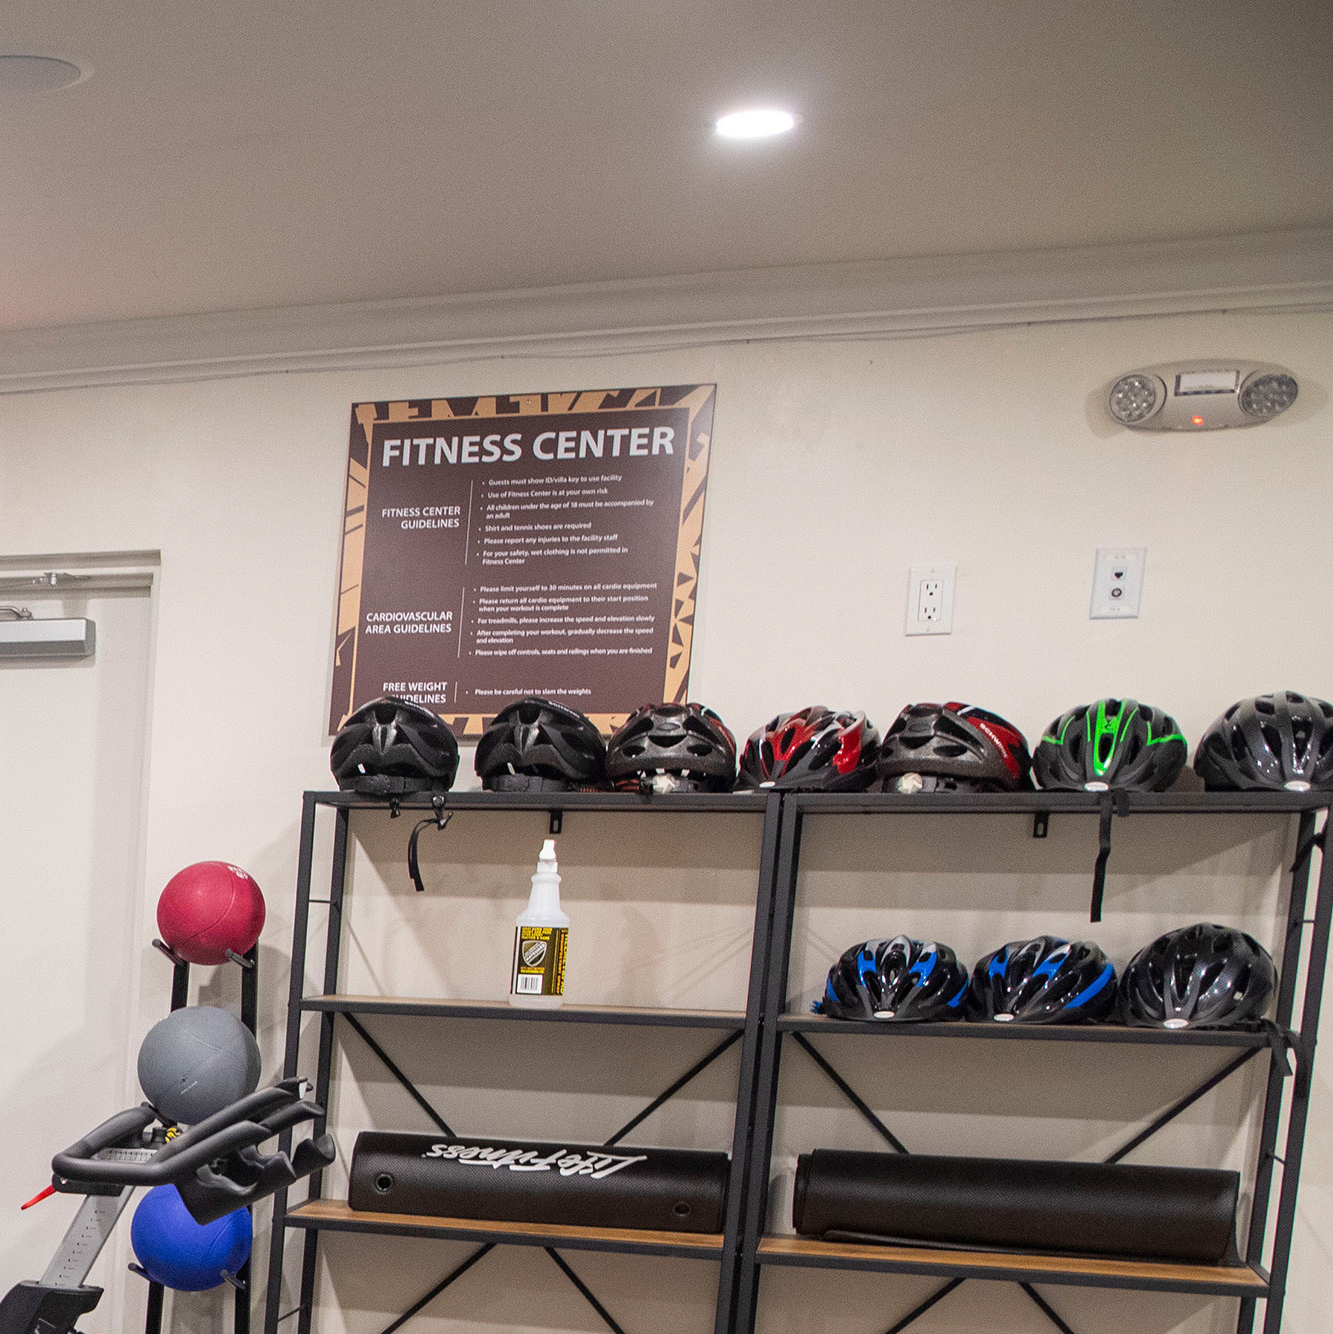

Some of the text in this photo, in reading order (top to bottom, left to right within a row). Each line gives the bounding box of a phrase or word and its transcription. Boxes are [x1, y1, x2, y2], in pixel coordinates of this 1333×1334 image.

[383, 426, 675, 467] FITNESS CENTER
[489, 478, 509, 486] Guests
[527, 477, 544, 485] show
[568, 476, 579, 484] key
[600, 475, 623, 483] facility
[508, 490, 529, 498] Fitness
[530, 489, 550, 497] Center
[495, 503, 519, 511] children
[520, 502, 538, 510] under
[550, 502, 562, 510] age
[578, 500, 594, 508] must
[604, 499, 645, 508] accompanied
[645, 498, 655, 506] by
[382, 505, 461, 518] FITNESS CENTER
[401, 518, 460, 530] GUIDELINES
[485, 524, 499, 532] Shirt
[514, 523, 533, 531] tennis
[564, 521, 592, 530] required
[484, 536, 503, 544] Please
[504, 536, 524, 544] report
[537, 535, 560, 544] injuries
[581, 534, 602, 542] facility
[483, 549, 493, 557] For
[543, 548, 569, 556] clothing
[588, 546, 620, 555] permitted
[482, 557, 503, 565] Fitness
[515, 584, 540, 592] yourself
[557, 583, 582, 591] minutes
[602, 582, 622, 590] cardio
[622, 582, 658, 590] equipment
[519, 596, 527, 604] all
[548, 595, 582, 604] equipment
[622, 594, 649, 603] position
[541, 604, 569, 612] complete
[366, 611, 453, 622] CARDIOVASCULAR
[519, 616, 538, 624] please
[564, 615, 574, 623] the
[575, 615, 593, 623] speed
[635, 614, 655, 622] slowly
[365, 623, 452, 634] AREA GUIDELINES
[492, 629, 525, 637] completing
[567, 628, 595, 636] gradually
[596, 627, 623, 635] decrease
[635, 627, 654, 635] speed
[382, 681, 448, 692] FREE WEIGHT
[568, 688, 592, 696] weights
